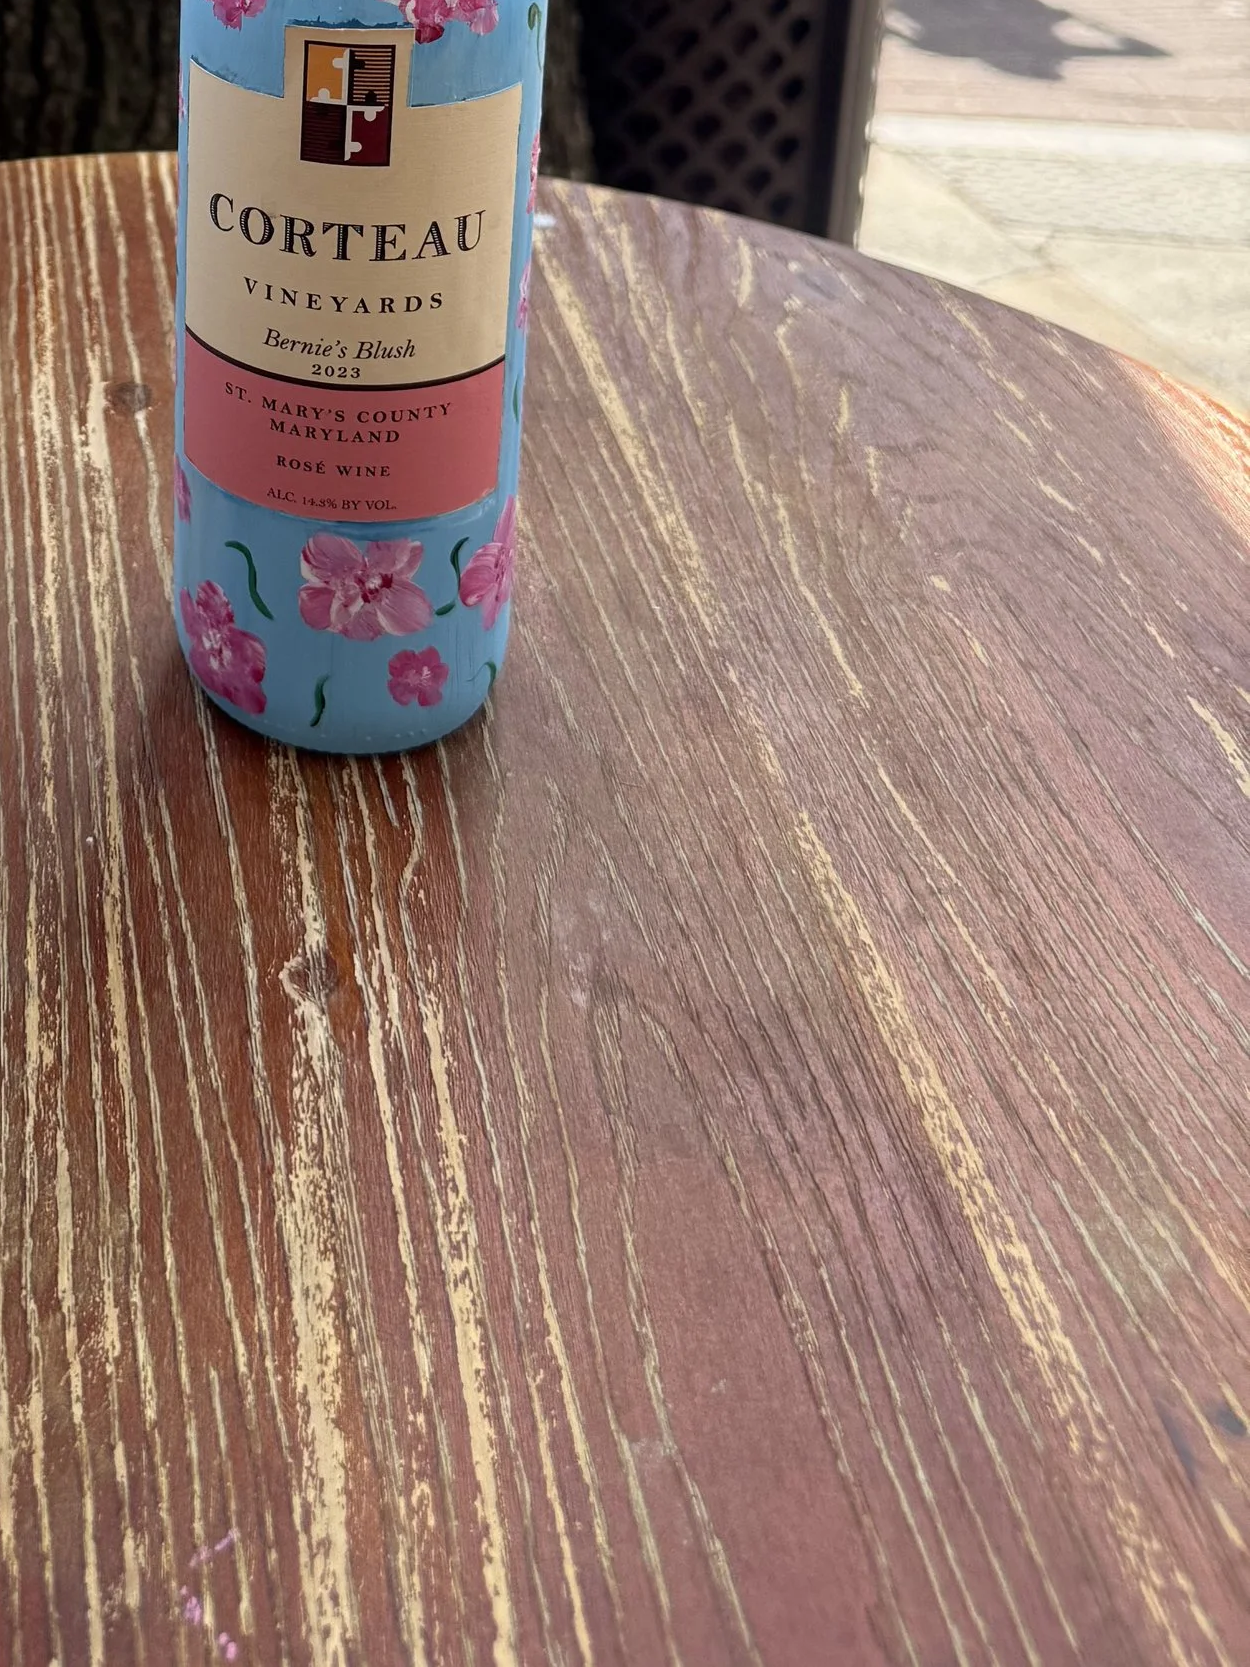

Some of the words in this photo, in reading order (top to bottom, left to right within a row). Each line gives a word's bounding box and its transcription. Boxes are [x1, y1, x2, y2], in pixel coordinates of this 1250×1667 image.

[209, 192, 487, 262] CORTEAU
[242, 276, 444, 315] VINEYARDS
[262, 327, 349, 360] Bernie's
[352, 339, 416, 360] Blush
[310, 363, 362, 380] 2023
[225, 381, 252, 404] ST.
[261, 395, 347, 424] MARY'S
[356, 402, 452, 424] COUNTY
[269, 417, 401, 444] MARYLAND
[276, 454, 327, 474] ROSÉ
[335, 465, 391, 478] WINE
[266, 487, 297, 503] ALC.
[341, 500, 362, 511] BY
[364, 499, 397, 511] VOL.
